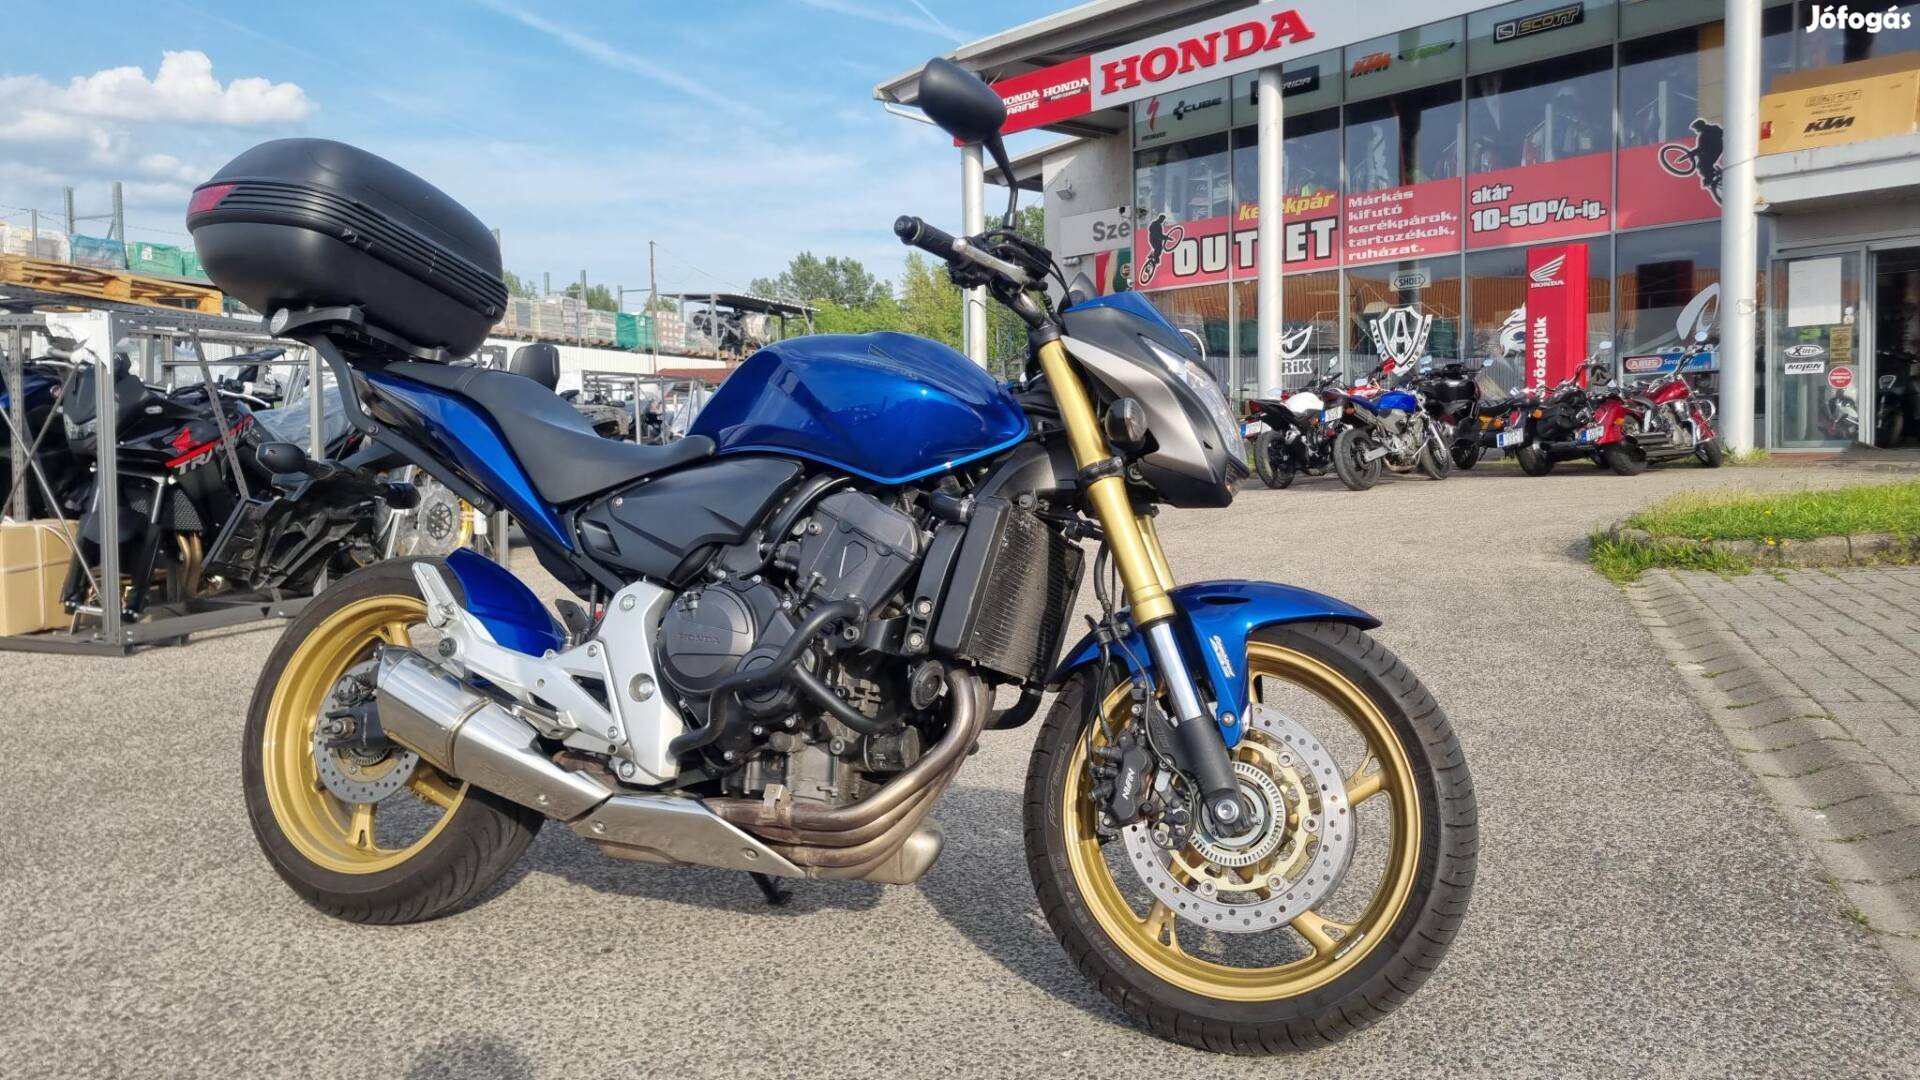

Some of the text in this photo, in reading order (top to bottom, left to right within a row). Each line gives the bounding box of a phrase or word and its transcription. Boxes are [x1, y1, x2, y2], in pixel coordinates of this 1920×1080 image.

[1520, 9, 1578, 32] SCOTT
[1101, 9, 1315, 95] HONDA
[1042, 78, 1090, 98] HONDA
[1007, 100, 1040, 115] ARINE
[1183, 97, 1222, 113] CUBE
[1804, 115, 1855, 133] KTM
[1349, 189, 1414, 208] Márkás
[1471, 184, 1513, 205] akár
[1239, 192, 1334, 221] kekpár
[1349, 205, 1403, 221] kifutó
[1470, 198, 1606, 233] 10-50%-ig.
[1092, 220, 1130, 242] Sze
[1349, 210, 1458, 235] kerékpárok,
[1172, 216, 1338, 277] OUTET
[1348, 227, 1456, 248] tartozékok,
[1348, 243, 1424, 261] ruházat.
[1530, 279, 1565, 289] HONDA
[1631, 359, 1658, 369] ABUS
